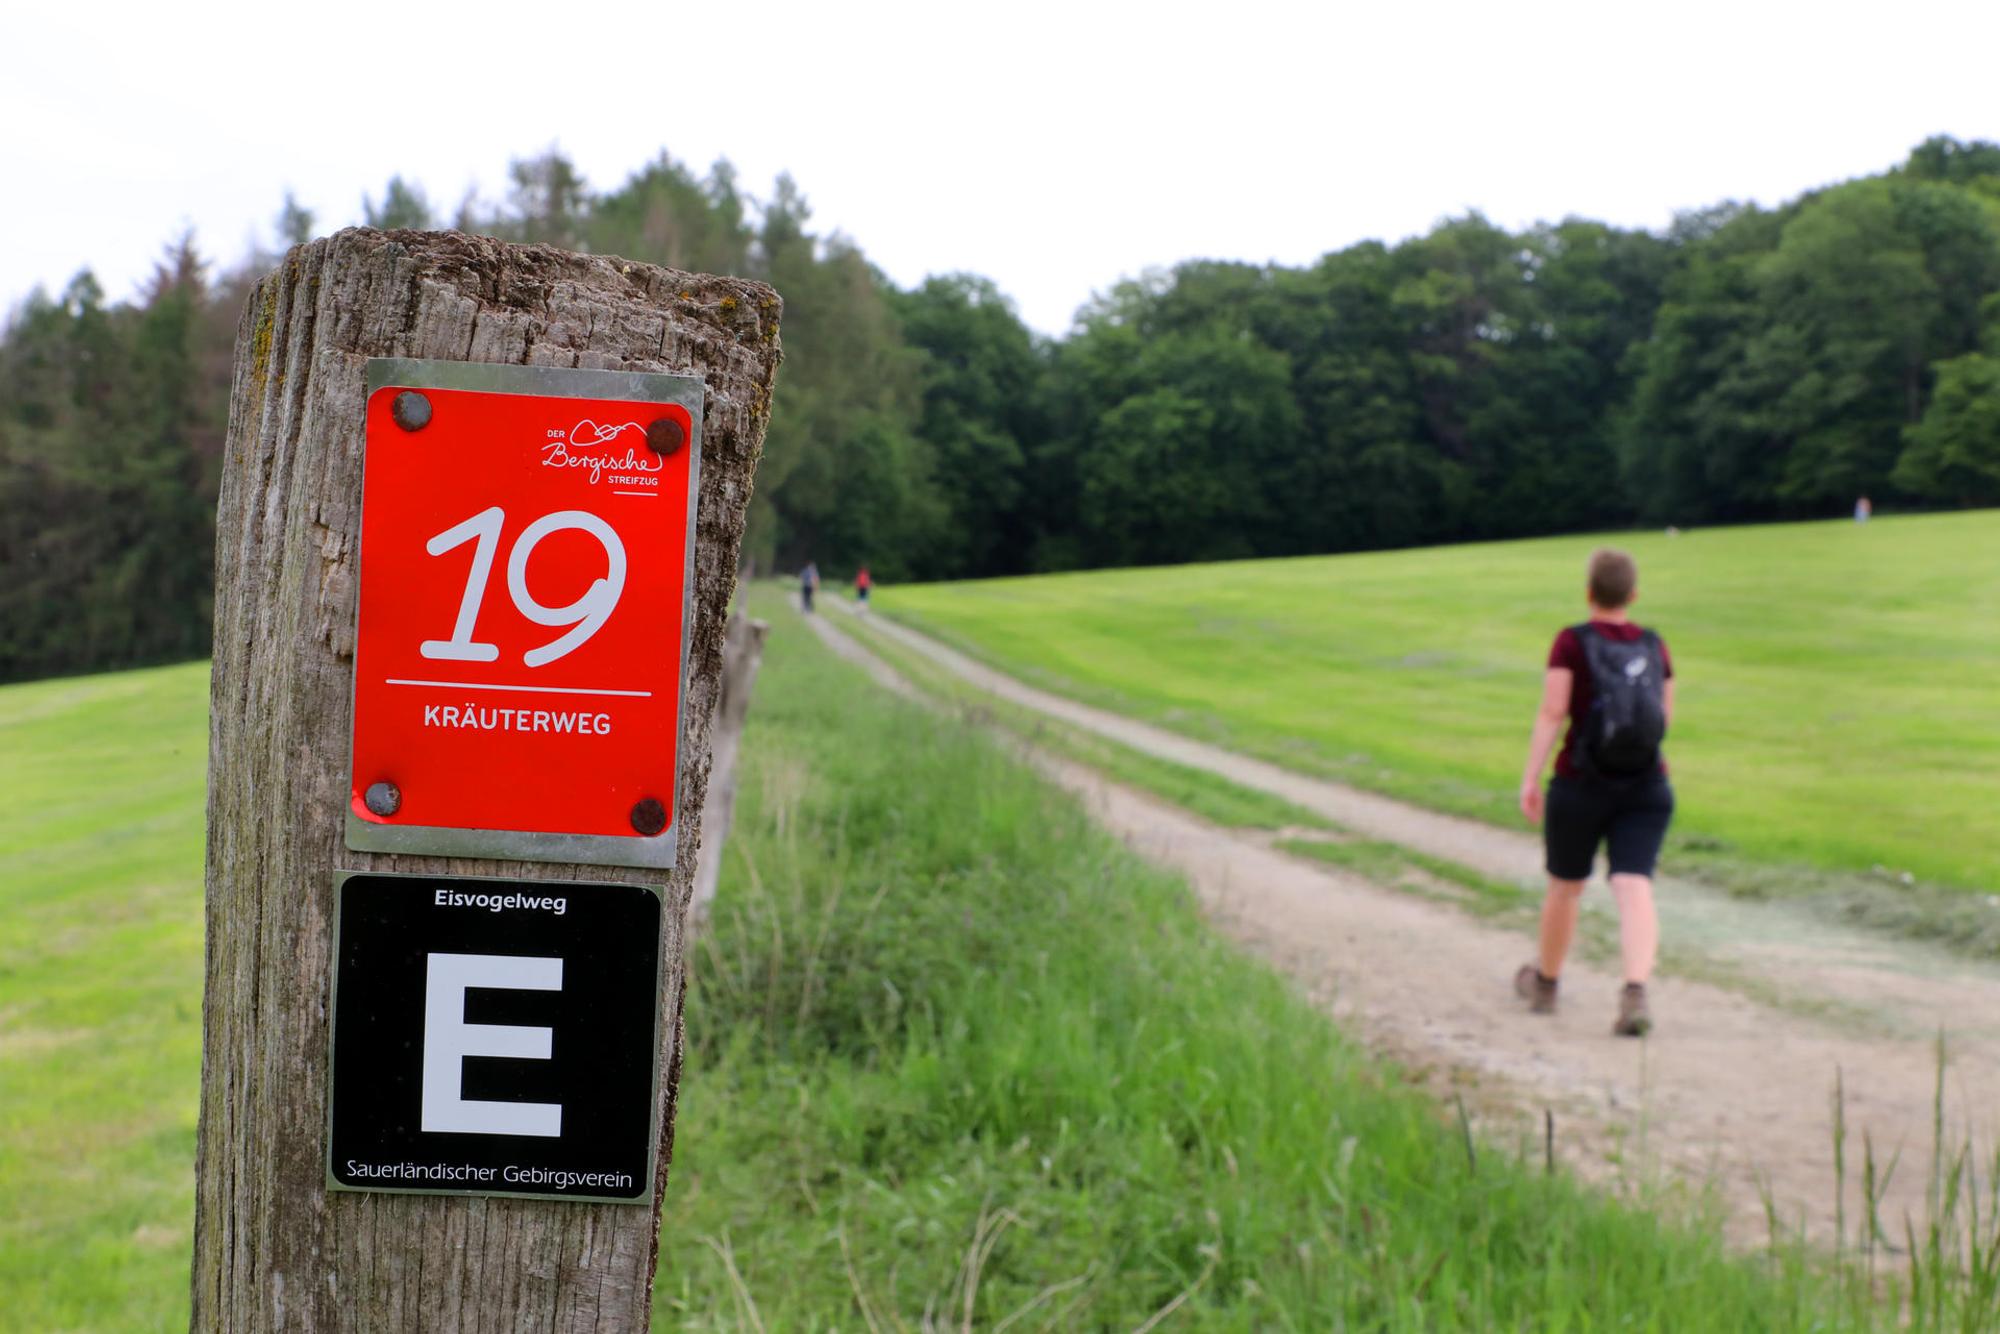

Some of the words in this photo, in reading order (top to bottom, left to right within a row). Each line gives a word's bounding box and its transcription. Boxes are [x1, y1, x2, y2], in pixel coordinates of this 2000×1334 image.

[547, 429, 566, 439] DER
[541, 442, 663, 485] Bergische
[607, 475, 658, 486] STREIFZUG
[420, 506, 627, 668] 19
[424, 703, 611, 735] KRÄUTERWEG
[434, 889, 567, 915] Eisvogelweg
[421, 952, 563, 1137] E
[346, 1159, 498, 1182] Sauerländischer
[503, 1165, 633, 1189] Gebirgsverein
